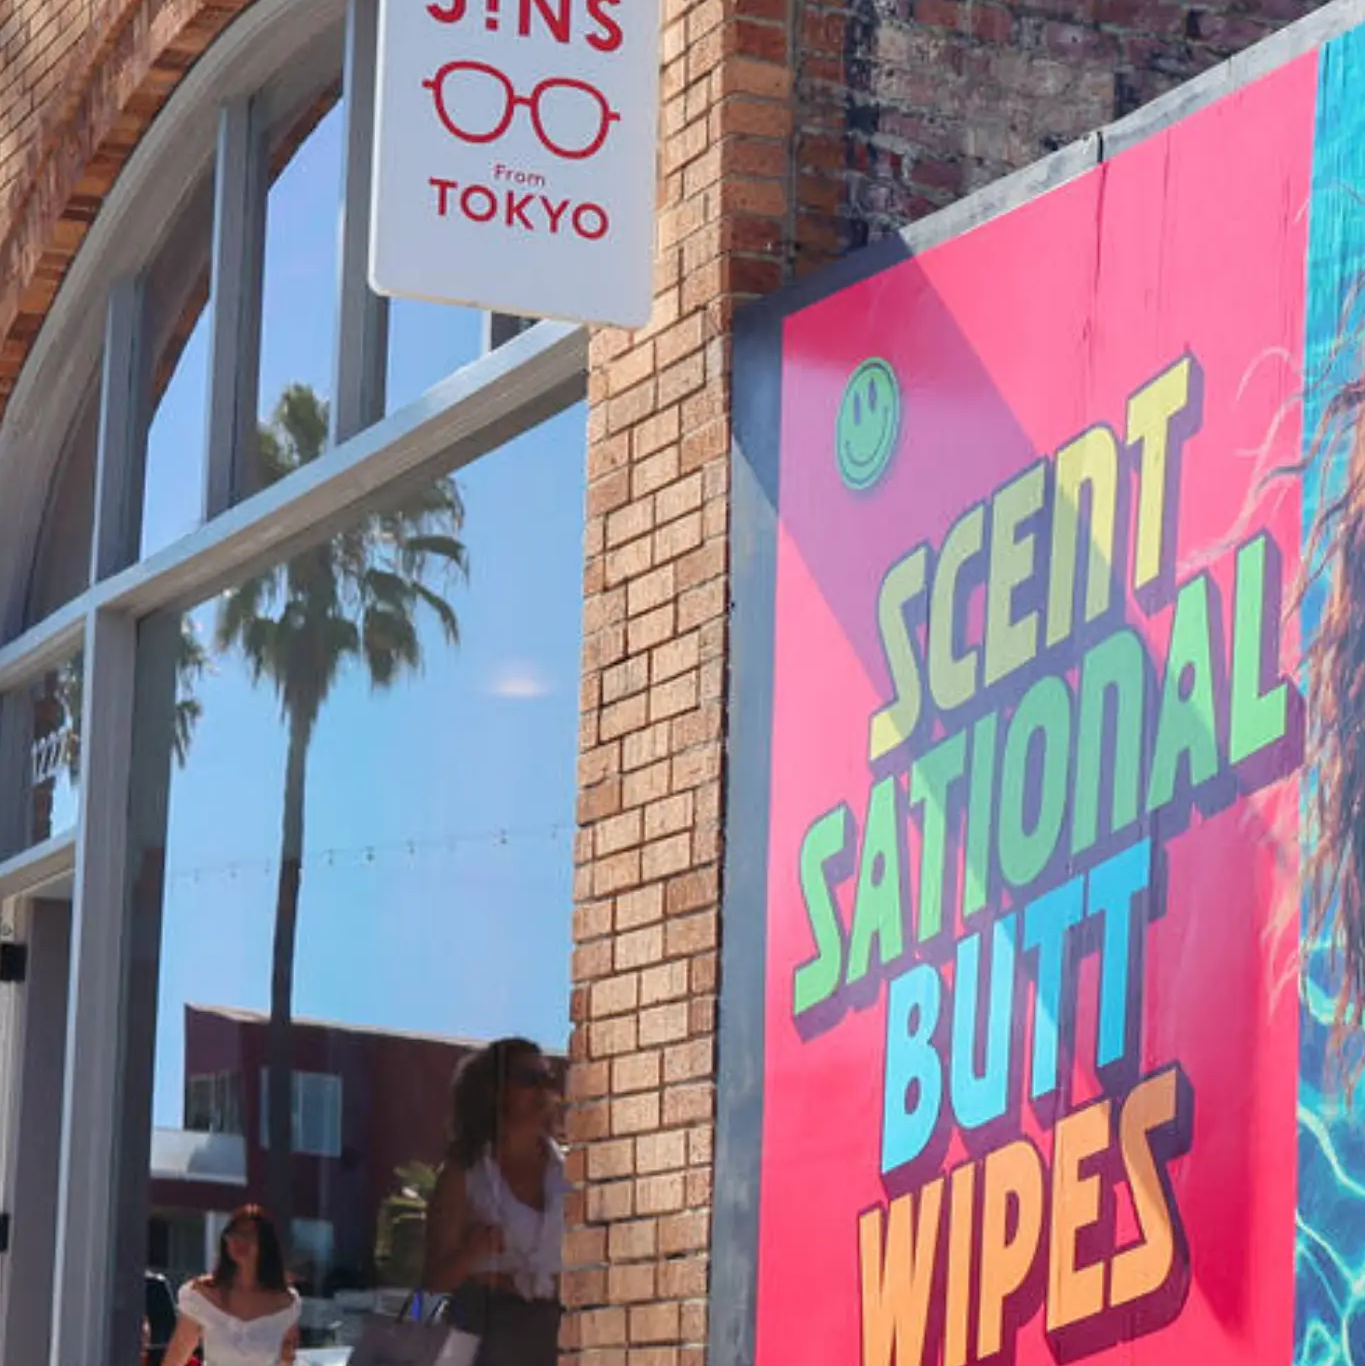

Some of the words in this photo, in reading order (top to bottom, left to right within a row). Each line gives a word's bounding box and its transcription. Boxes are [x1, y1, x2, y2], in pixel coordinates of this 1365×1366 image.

[429, 177, 609, 240] TOKYO
[494, 164, 545, 186] From
[868, 357, 1192, 761] SCENT
[795, 533, 1290, 1015] SATIONAL
[882, 843, 1151, 1175] BUTT
